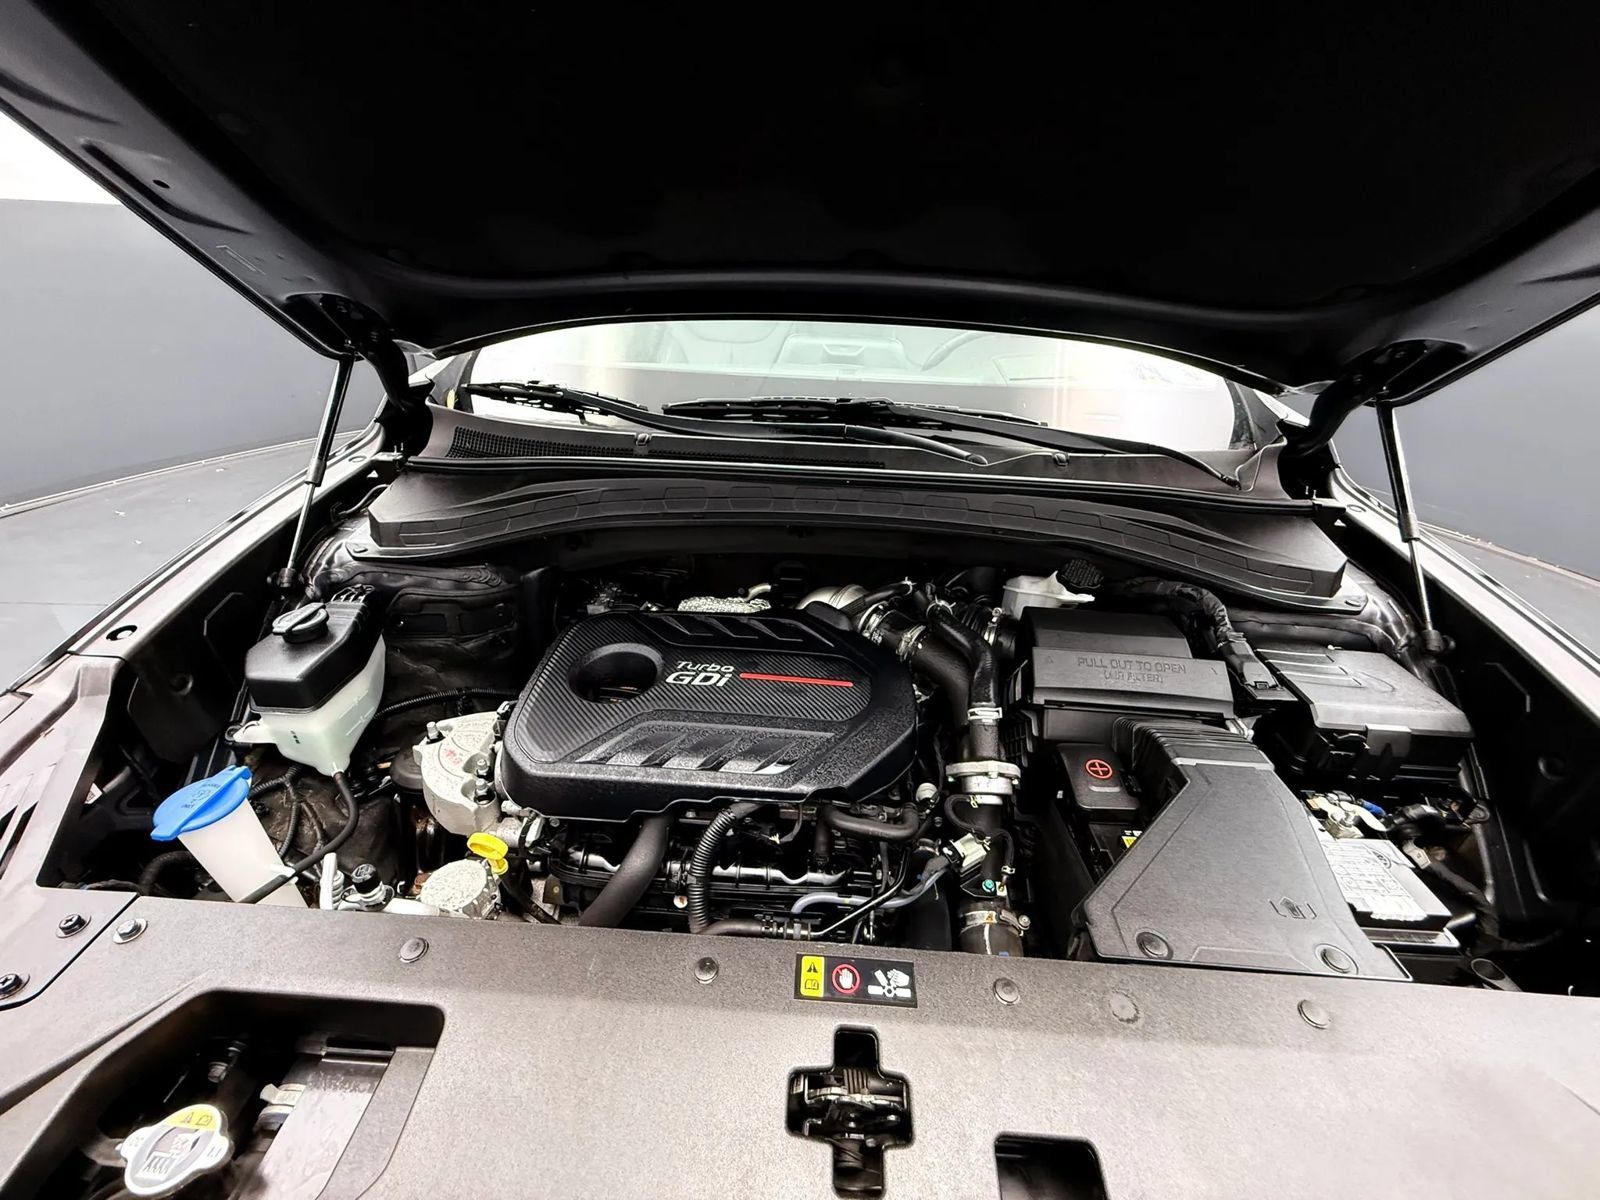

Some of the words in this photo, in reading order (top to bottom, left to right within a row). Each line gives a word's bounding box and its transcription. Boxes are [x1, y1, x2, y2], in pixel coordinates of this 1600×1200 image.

[676, 660, 735, 672] Turbo
[1077, 656, 1108, 669] PULL
[1110, 658, 1134, 670] OUT
[1135, 660, 1152, 672] TO
[1154, 662, 1187, 674] OPEN
